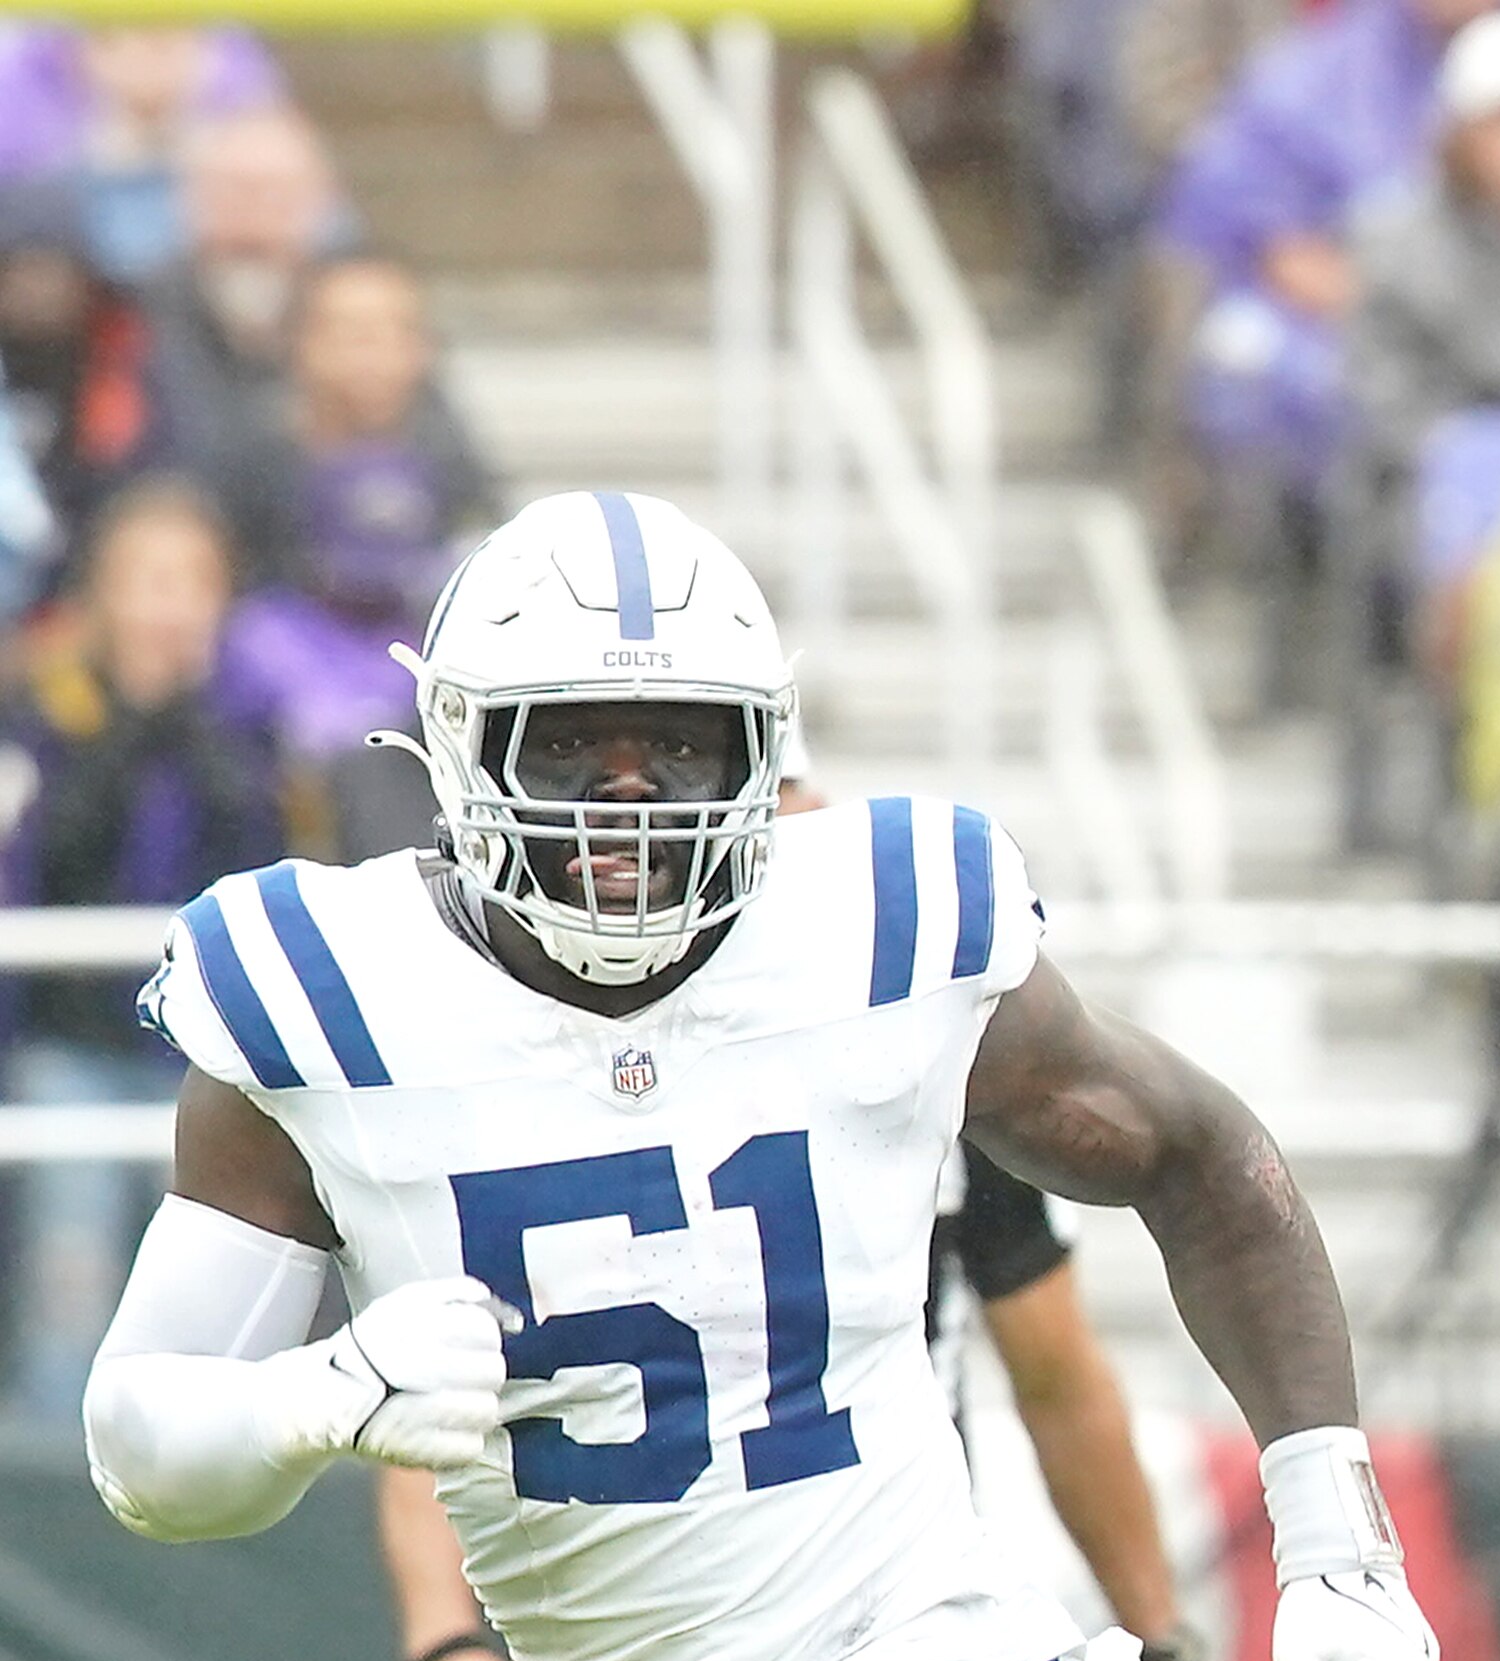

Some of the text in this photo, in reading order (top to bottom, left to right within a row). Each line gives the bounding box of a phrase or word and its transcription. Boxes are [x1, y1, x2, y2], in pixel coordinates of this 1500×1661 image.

[603, 650, 673, 669] COLTS
[618, 1066, 653, 1091] NFL
[448, 1129, 862, 1505] 51
